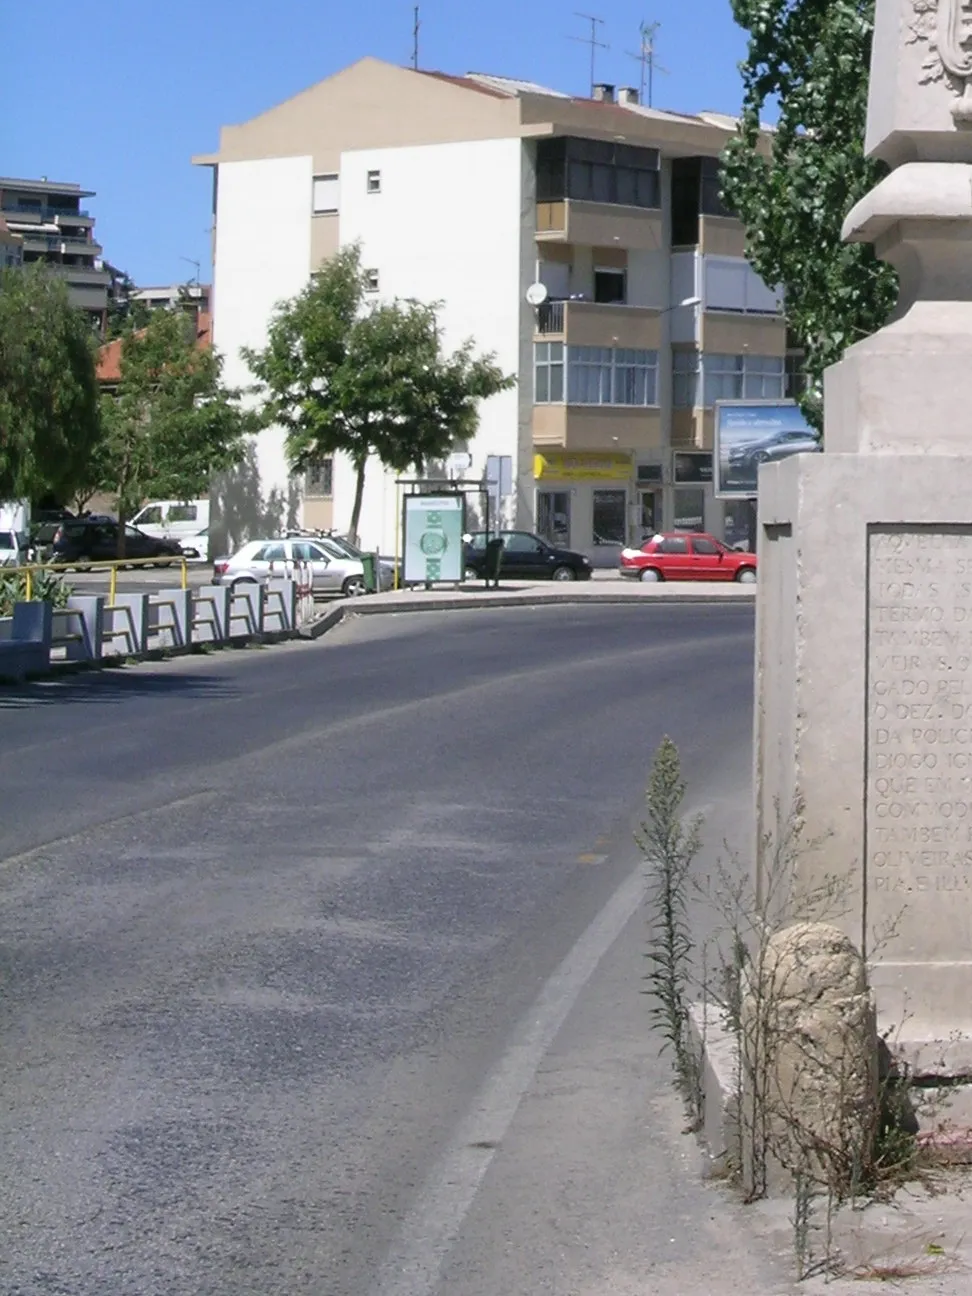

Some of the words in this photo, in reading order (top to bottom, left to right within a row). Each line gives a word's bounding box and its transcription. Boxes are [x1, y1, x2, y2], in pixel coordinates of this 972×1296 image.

[876, 582, 938, 598] TODAS
[876, 606, 944, 622] TERMO
[874, 680, 929, 695] GADO
[876, 728, 901, 744] DA
[875, 752, 937, 769] DIOGO
[875, 777, 918, 798] QUE
[875, 827, 960, 842] TAMBEM
[874, 850, 972, 867] OLIVEIRAS
[917, 876, 928, 891] E
